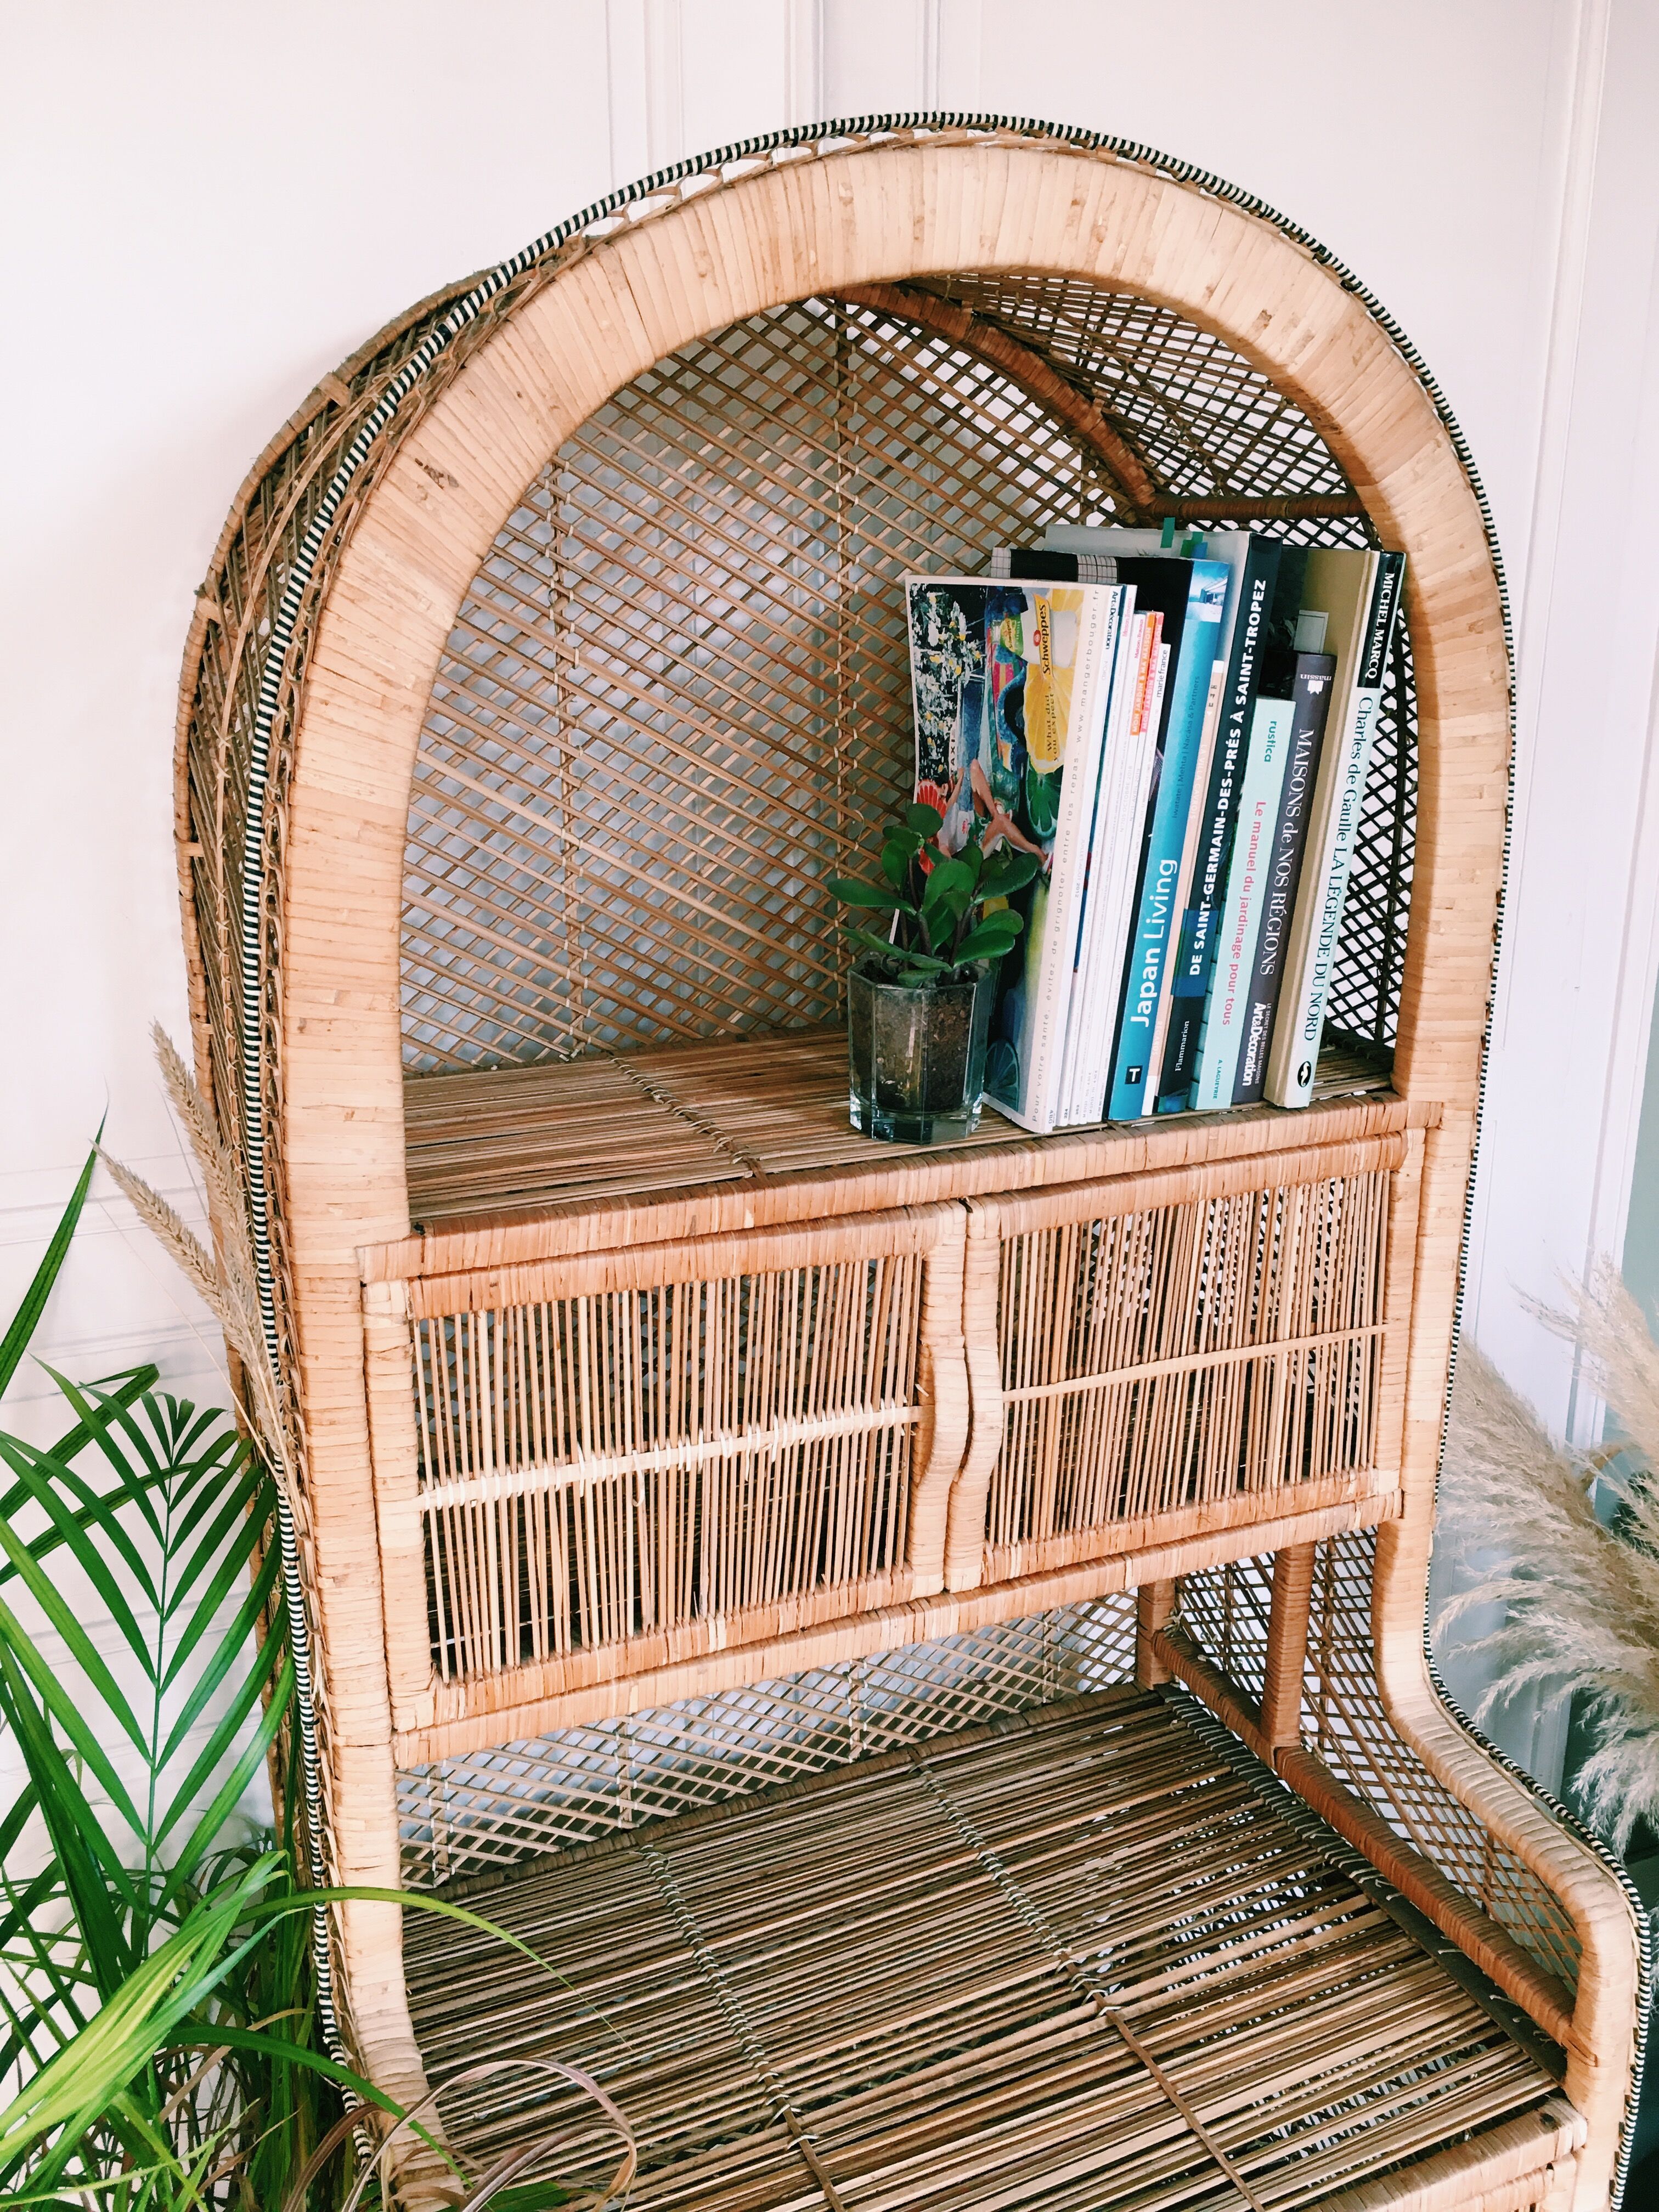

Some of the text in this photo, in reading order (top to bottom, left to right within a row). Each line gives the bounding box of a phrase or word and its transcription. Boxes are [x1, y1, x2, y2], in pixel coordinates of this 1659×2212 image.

[1039, 604, 1051, 675] Schweppes
[1142, 627, 1152, 659] MAISON
[1365, 572, 1395, 679] MICHEL MARCQ
[1076, 590, 1099, 743] www.mangerbouger.fr
[1141, 661, 1148, 673] MA
[1144, 679, 1154, 709] JARDIN
[1150, 657, 1157, 670] MA
[1158, 650, 1168, 675] france
[1300, 673, 1332, 681] massin
[1135, 683, 1144, 712] JARDIN
[1172, 788, 1181, 818] Iwatate
[1178, 756, 1187, 782] Mehta
[1189, 676, 1200, 710] Partners
[1263, 720, 1277, 763] rustica
[1189, 579, 1266, 976] DE SAINT-GERMAIN-DES-PRÉS À SAINT-TROPEZ
[1260, 728, 1315, 975] MAISONS de NOS RÉGIONS
[1304, 696, 1373, 1042] Charles de Gaulle LA LÉGENDE DU NORD
[1054, 872, 1065, 932] grignoter
[1222, 801, 1266, 1025] Le manuel du jardinage pour tous
[1052, 940, 1058, 955] de
[1130, 859, 1178, 1027] Japan Living
[1046, 963, 1055, 1001] évitez
[1175, 1020, 1189, 1071] Flammarion
[1242, 1002, 1267, 1086] Art&Décoration
[1213, 1066, 1222, 1099] LAGUEYRIE
